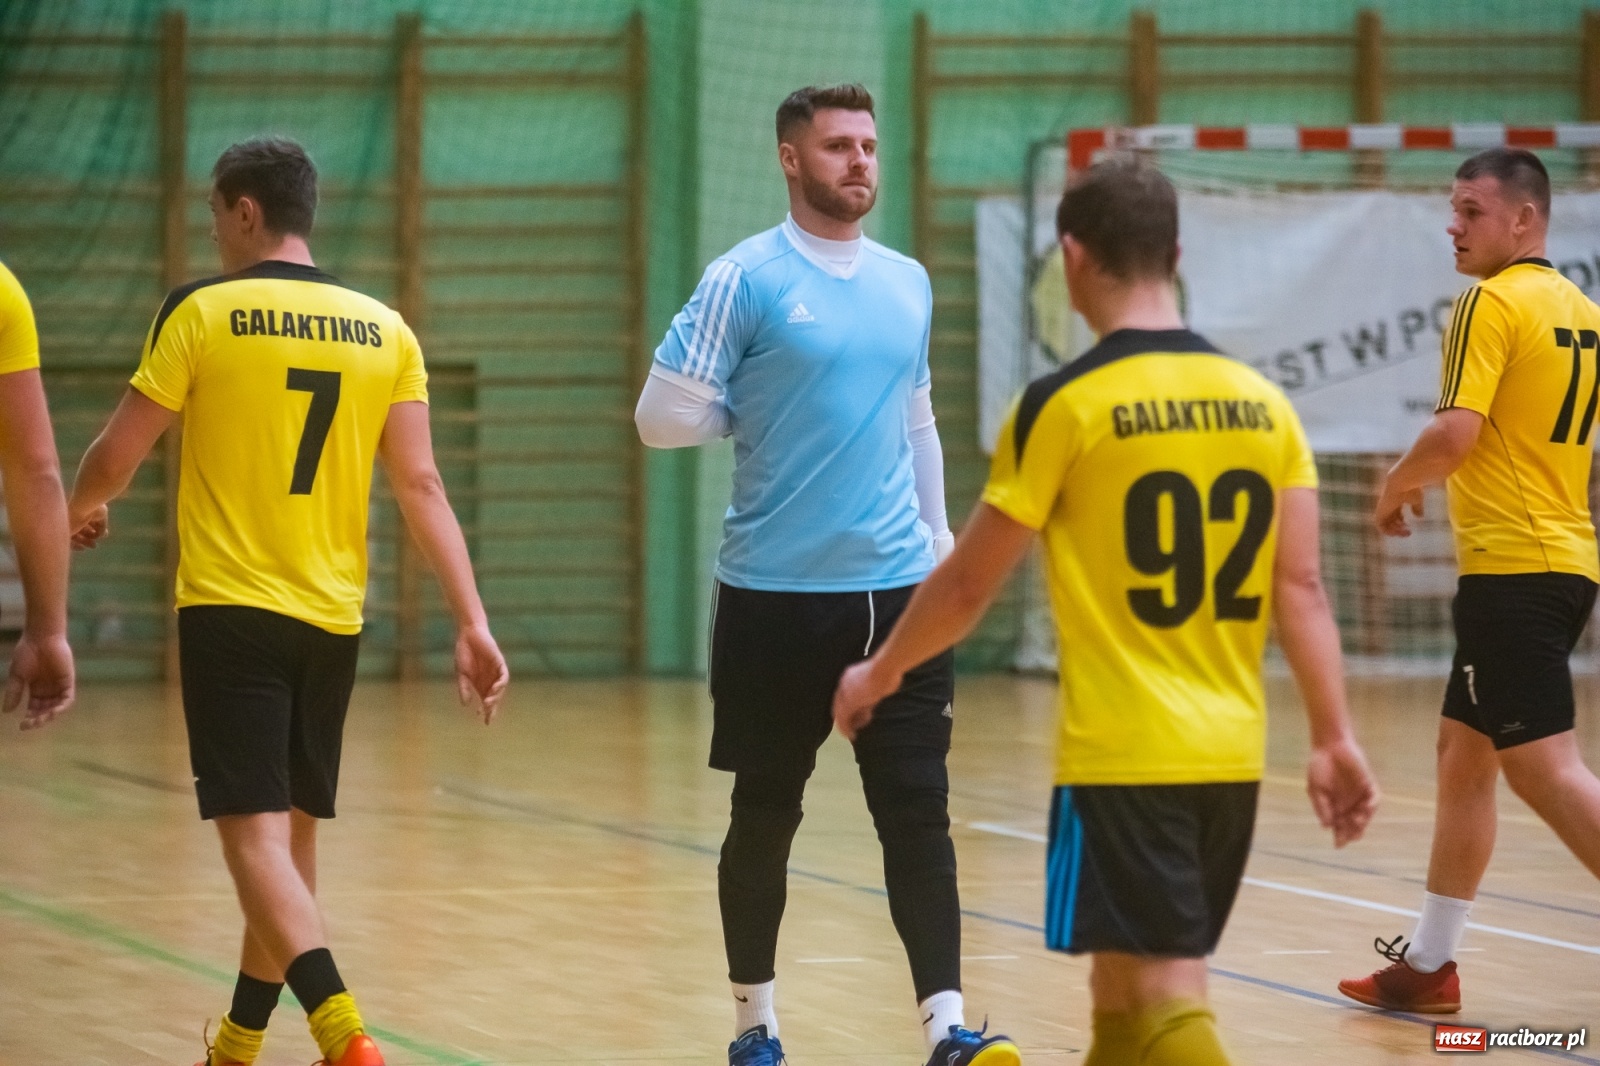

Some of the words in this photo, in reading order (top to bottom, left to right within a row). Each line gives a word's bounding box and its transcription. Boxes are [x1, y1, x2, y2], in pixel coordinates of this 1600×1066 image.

[230, 309, 382, 348] GALAKTIKOS
[1340, 317, 1389, 368] W
[1111, 399, 1274, 440] GALAKTIKOS
[1549, 327, 1600, 446] 77
[286, 367, 341, 495] 7
[1123, 468, 1275, 629] 92
